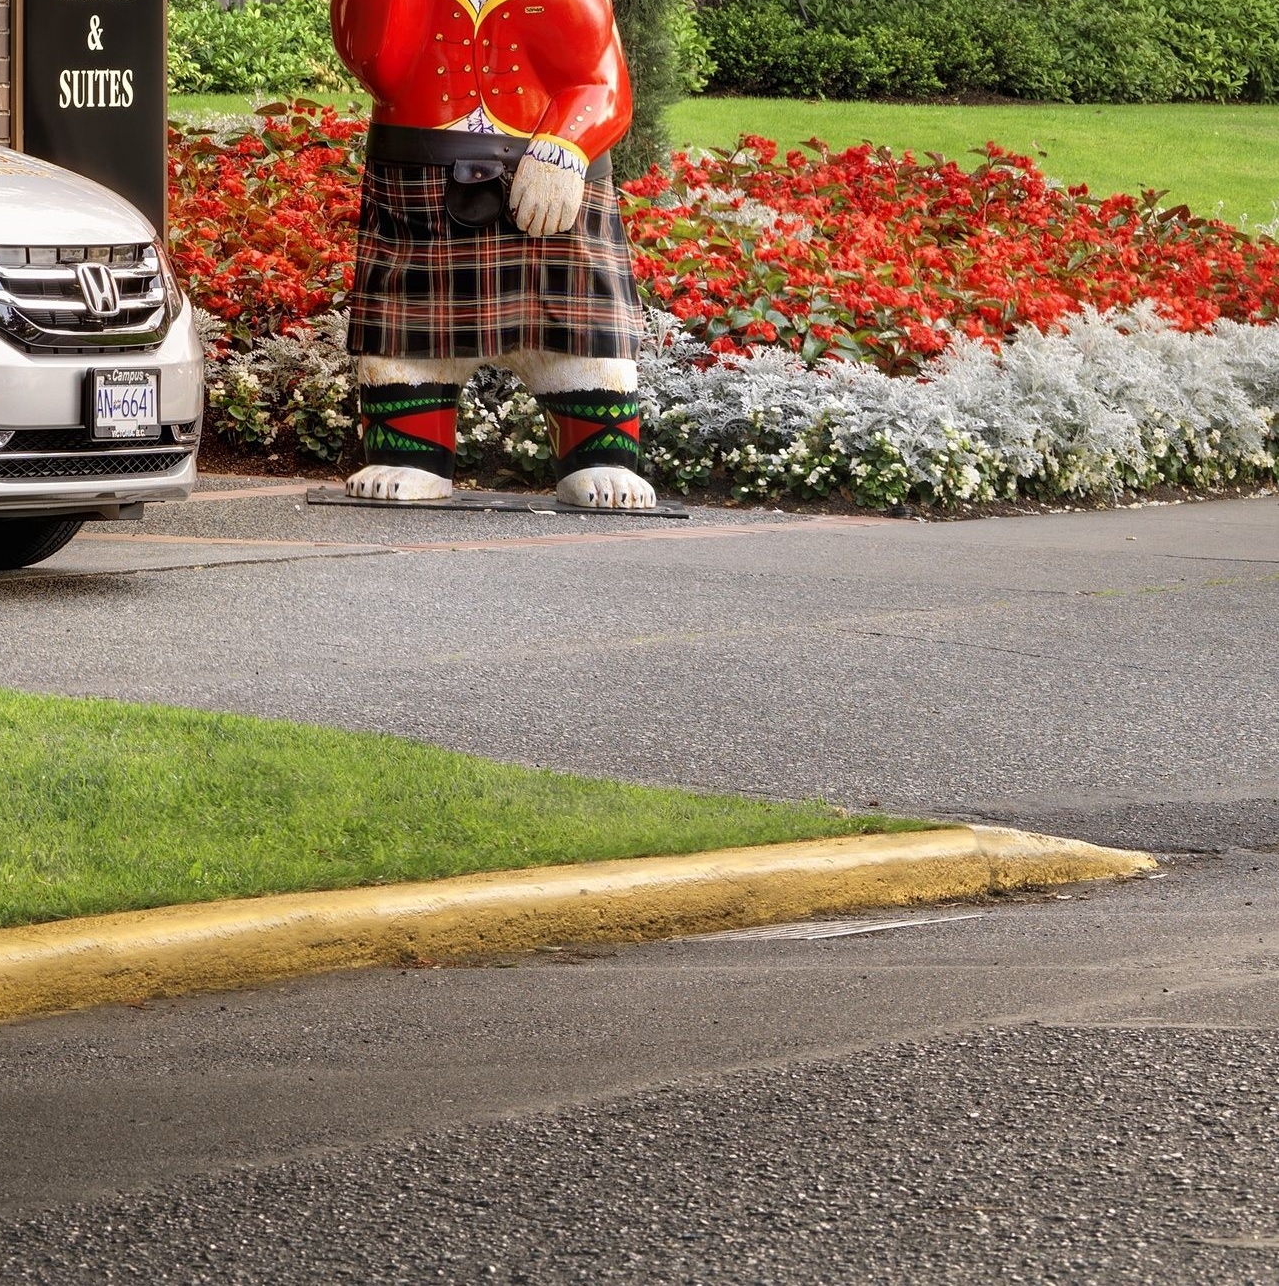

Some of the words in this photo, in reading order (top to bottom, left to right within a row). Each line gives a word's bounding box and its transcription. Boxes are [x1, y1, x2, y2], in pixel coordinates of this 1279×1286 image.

[87, 14, 104, 51] &
[59, 68, 134, 109] SUITES
[112, 369, 144, 384] Campus
[122, 388, 154, 417] 6641
